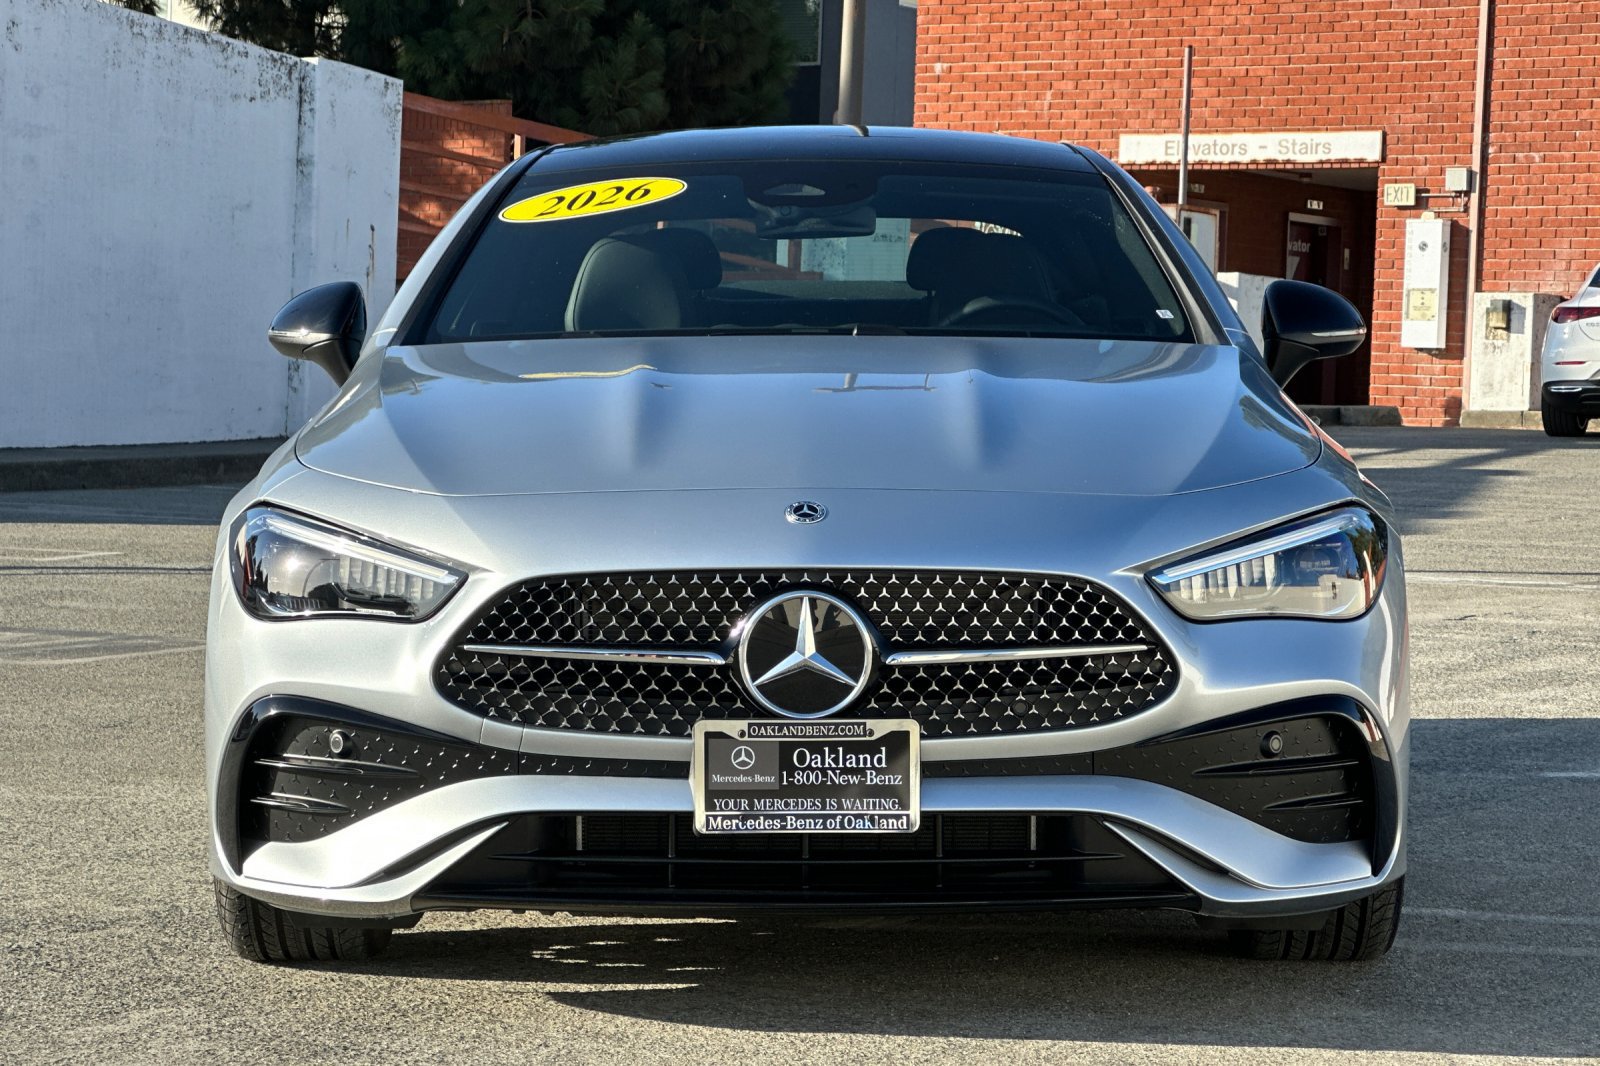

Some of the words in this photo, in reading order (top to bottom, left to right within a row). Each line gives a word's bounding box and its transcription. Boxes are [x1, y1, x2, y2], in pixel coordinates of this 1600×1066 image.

[1164, 139, 1248, 157] Elvators
[1278, 138, 1332, 155] Stairs
[534, 179, 659, 218] 2026
[1386, 185, 1413, 203] EXIT
[749, 725, 865, 736] OAKLANDBENZ.COM
[793, 747, 887, 768] Oakland
[711, 774, 776, 783] Mercedes-Benz
[781, 770, 903, 785] 1-800-New-Benz
[713, 798, 750, 811] YOUR
[753, 798, 822, 811] MERCEDES
[826, 798, 838, 811] IS
[841, 798, 902, 811] WAITING.
[708, 815, 823, 830] Mercedes-Benz
[826, 816, 842, 830] of
[844, 815, 908, 830] Oakland
